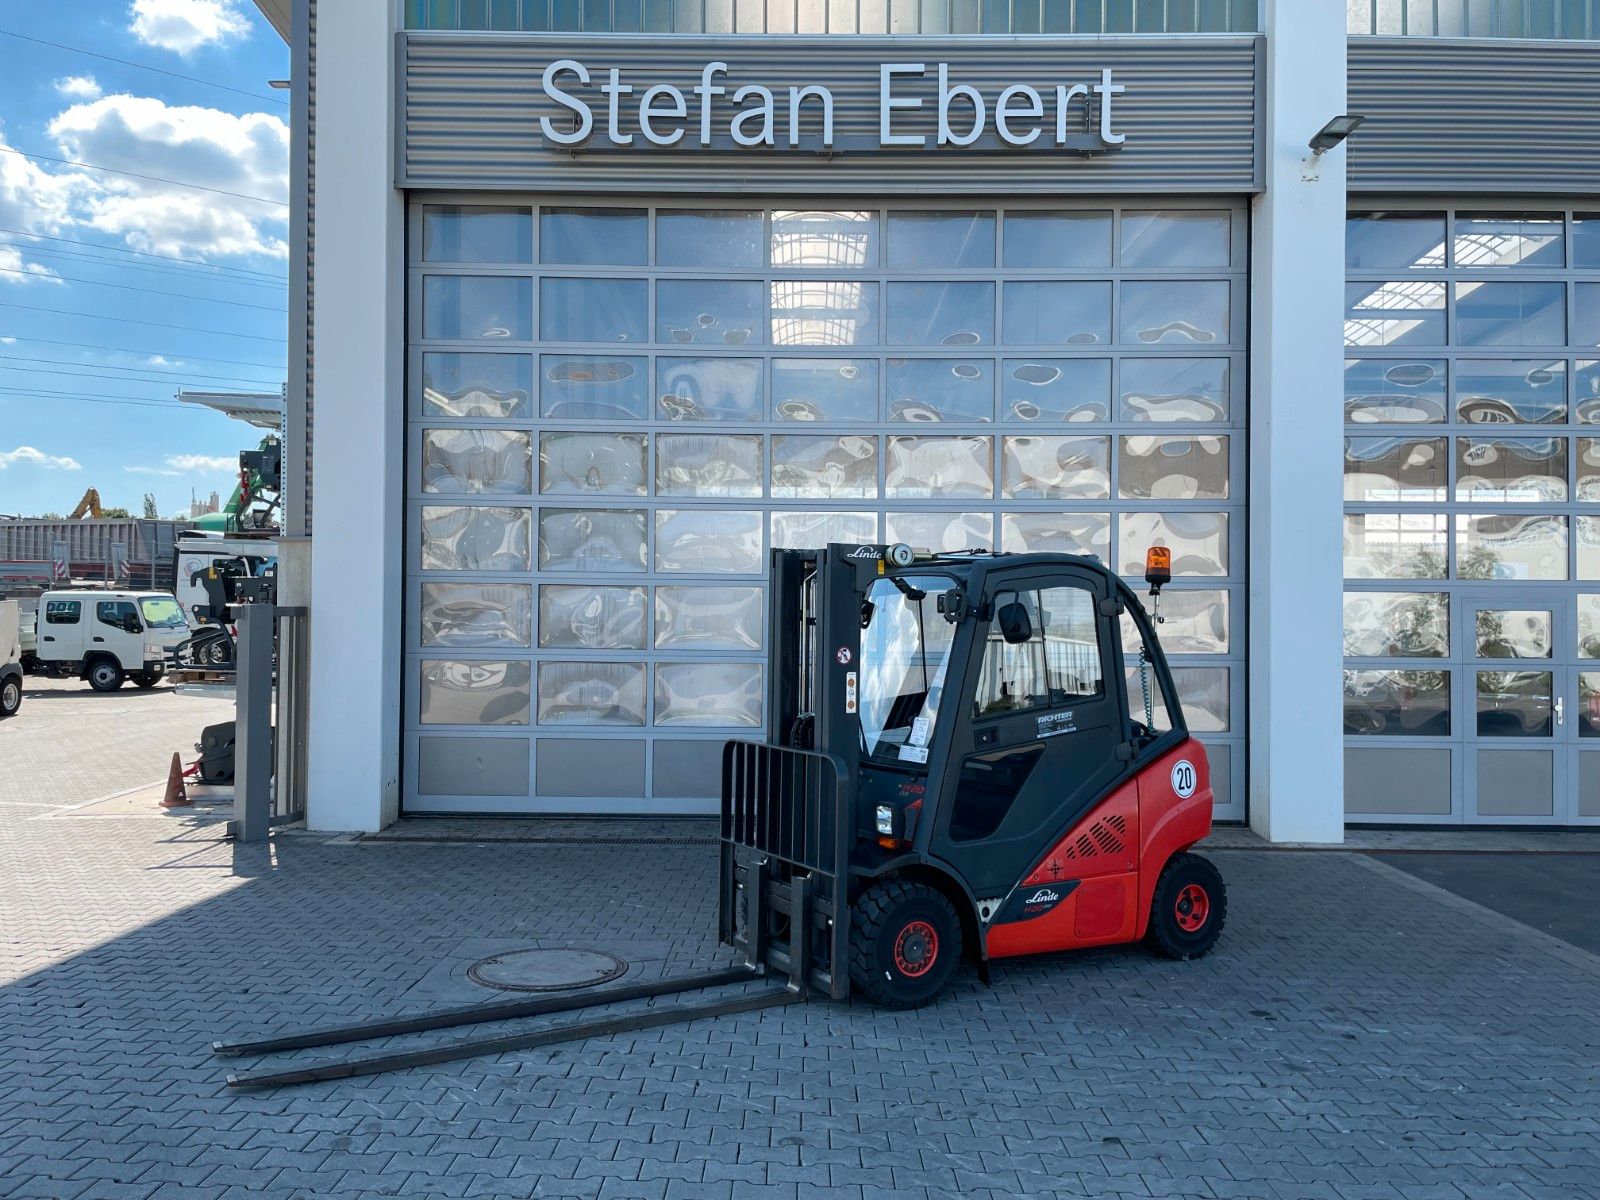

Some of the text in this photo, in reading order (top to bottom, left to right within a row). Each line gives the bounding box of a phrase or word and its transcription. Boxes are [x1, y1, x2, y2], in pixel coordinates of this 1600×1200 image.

[540, 59, 1126, 147] Stefan Ebert
[847, 545, 882, 559] Linde
[1177, 767, 1192, 790] 20
[1025, 889, 1059, 904] Linde
